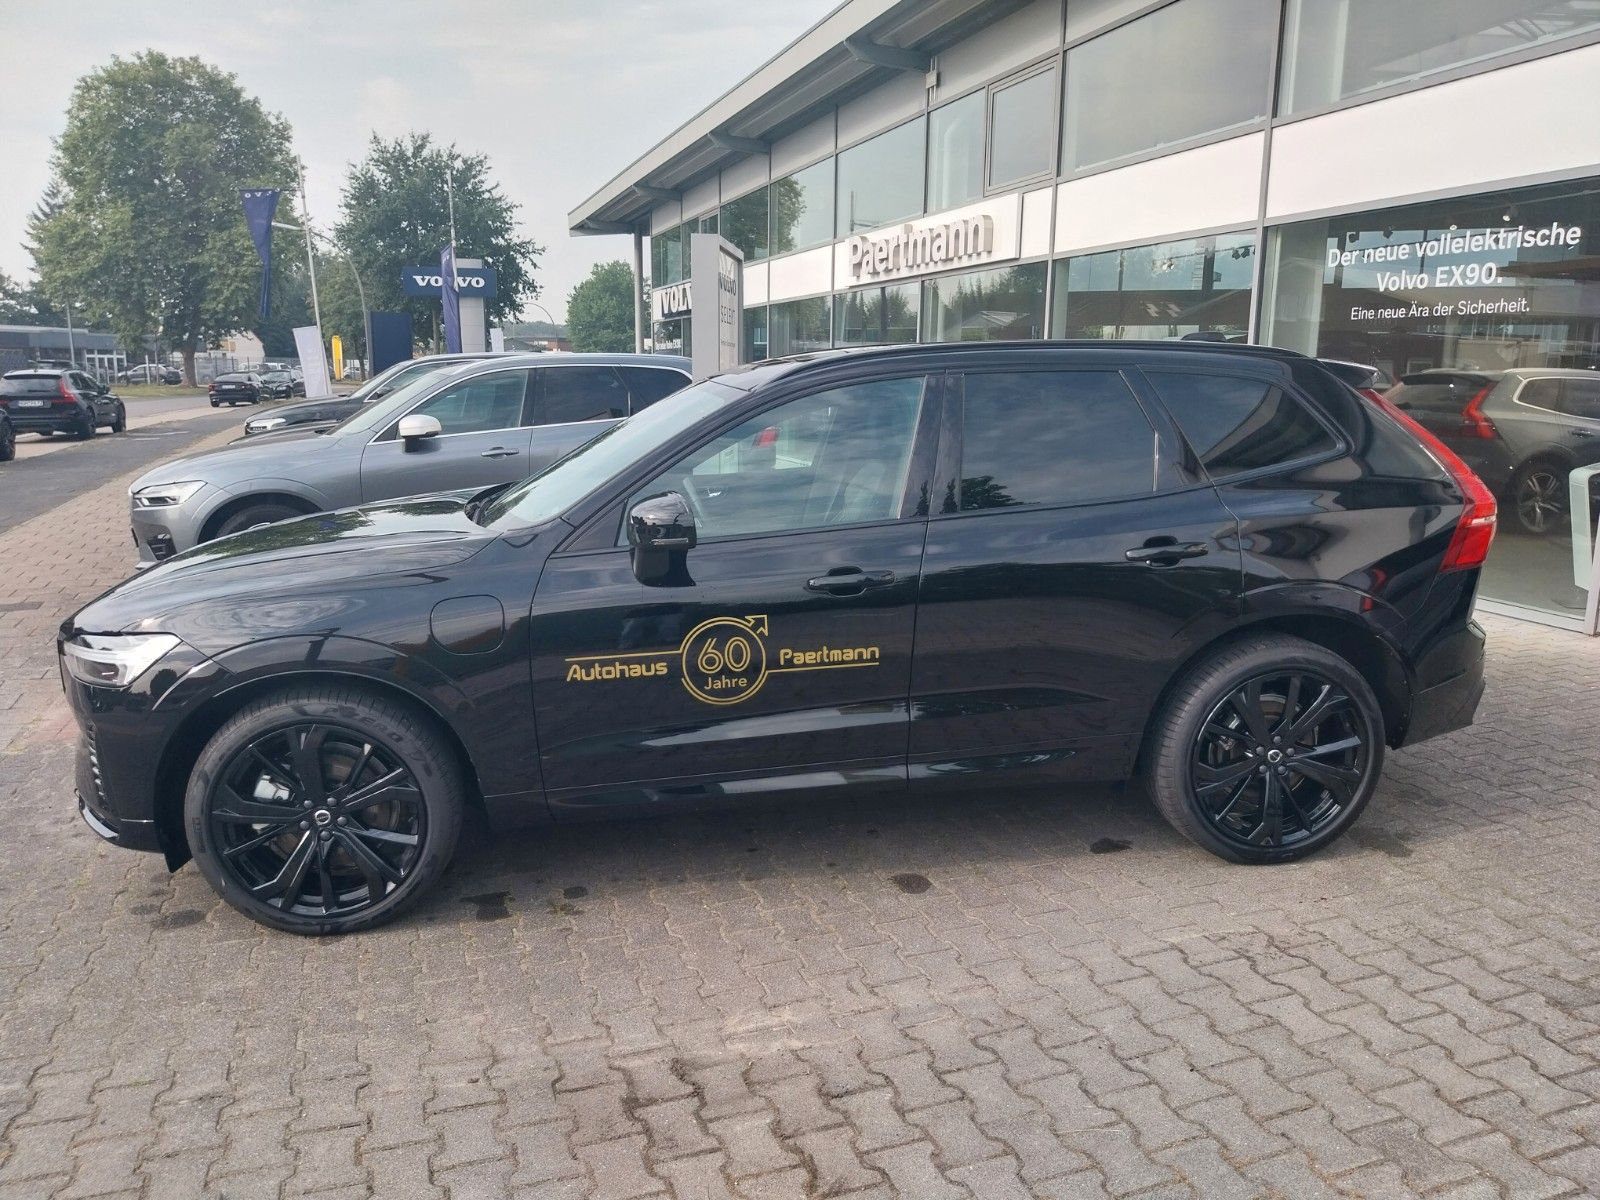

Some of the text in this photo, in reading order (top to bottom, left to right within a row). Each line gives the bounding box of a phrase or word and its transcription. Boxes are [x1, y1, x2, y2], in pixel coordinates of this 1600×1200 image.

[848, 215, 992, 278] Paertmann
[1327, 221, 1582, 268] Der neue vollelektrische
[412, 275, 485, 288] VOVO
[1376, 261, 1503, 293] Volvo EX90.
[661, 283, 692, 315] VOLV
[1351, 297, 1531, 320] Eine neue Ära der Sicherheit.
[697, 636, 751, 675] 60
[779, 646, 880, 666] Paertmann
[566, 660, 668, 683] Autohaus
[704, 675, 748, 691] Jahre
